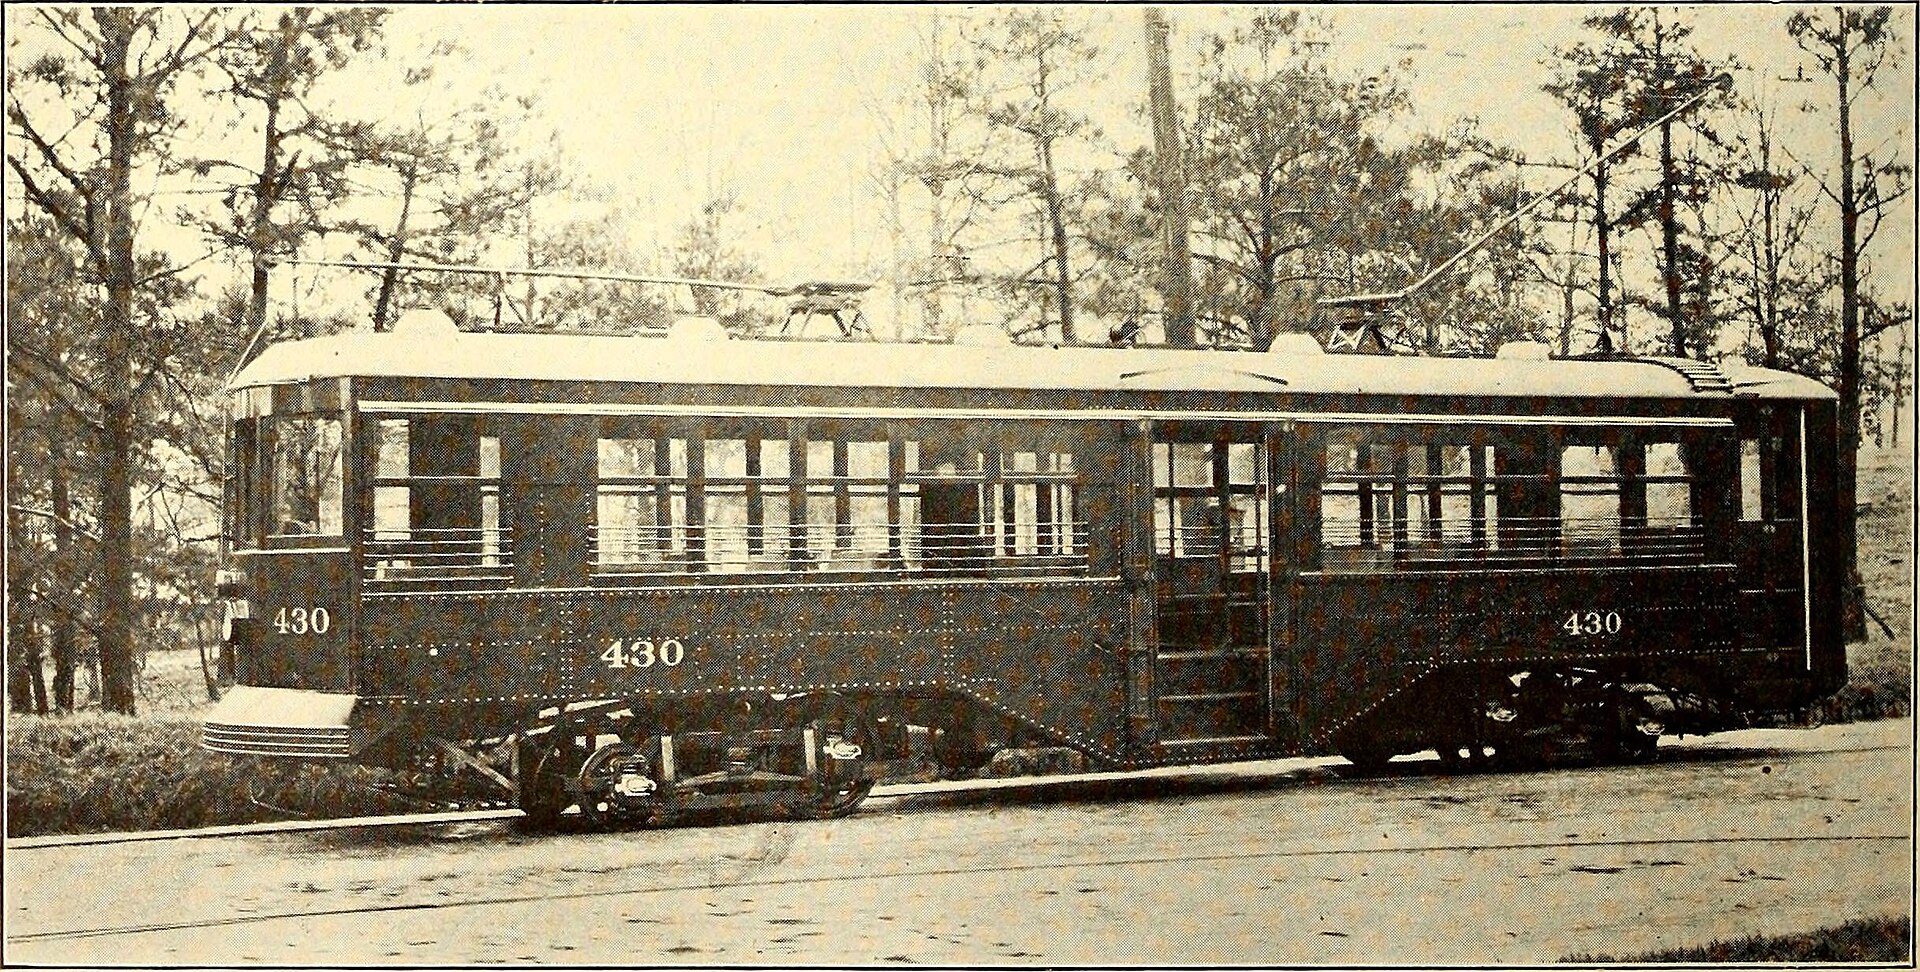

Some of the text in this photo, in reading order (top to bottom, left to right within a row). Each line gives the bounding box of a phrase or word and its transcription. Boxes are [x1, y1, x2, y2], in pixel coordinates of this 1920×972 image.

[273, 607, 330, 635] 430
[1562, 612, 1622, 635] 430
[600, 639, 684, 668] 430
